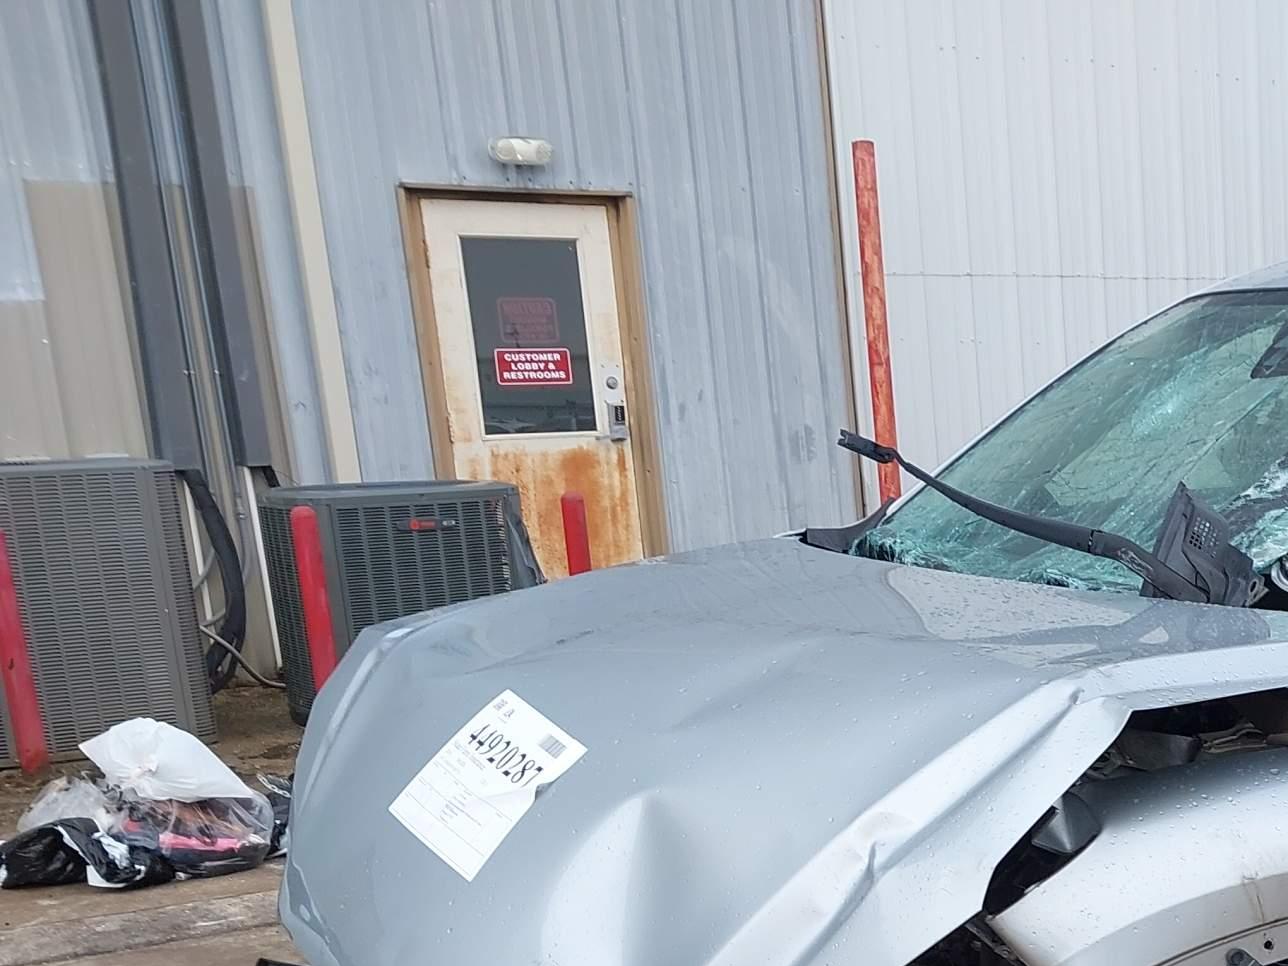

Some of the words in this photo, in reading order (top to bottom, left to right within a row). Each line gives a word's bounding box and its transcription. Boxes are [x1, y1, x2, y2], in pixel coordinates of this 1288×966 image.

[503, 353, 561, 362] CUSTOMER
[510, 362, 545, 370] LOBBY
[547, 362, 556, 370] &
[502, 371, 566, 380] RESTROOMS
[467, 723, 544, 788] 44920287
